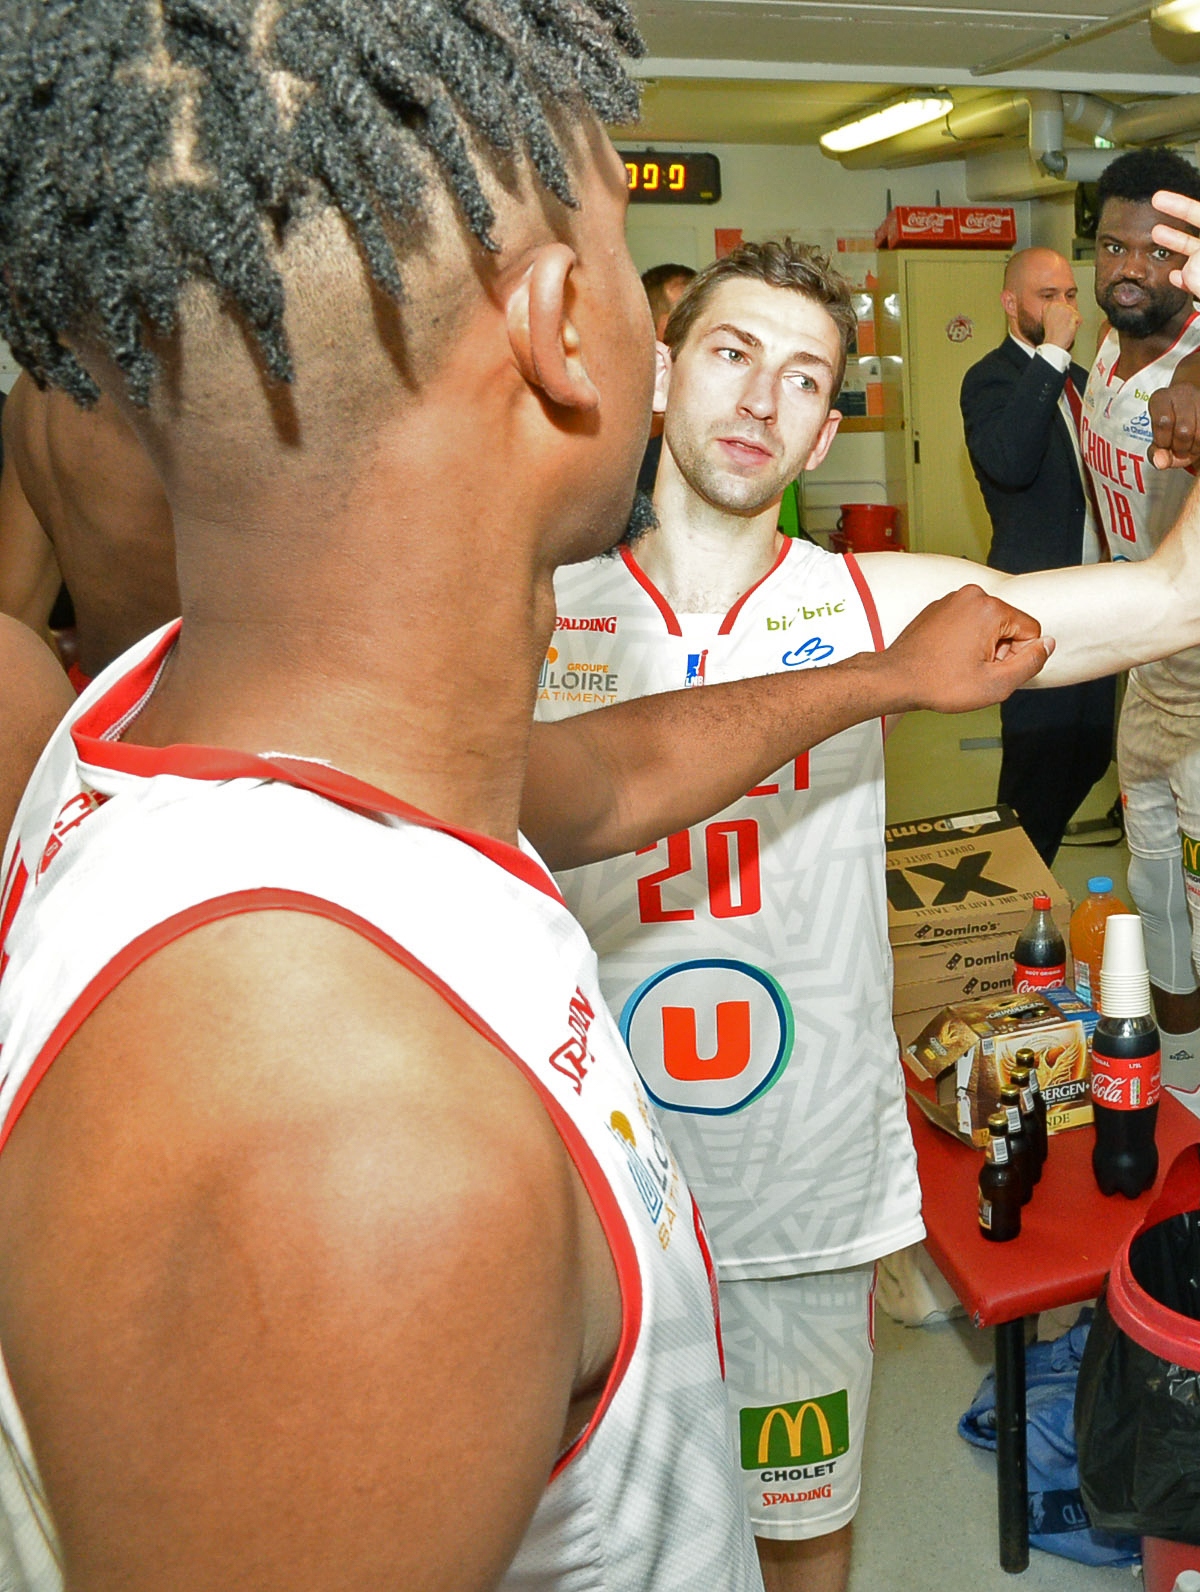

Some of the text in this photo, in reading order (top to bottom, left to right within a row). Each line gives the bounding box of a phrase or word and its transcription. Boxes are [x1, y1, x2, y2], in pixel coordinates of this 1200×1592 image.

[1081, 415, 1146, 495] CHOLET
[1102, 483, 1137, 543] 18
[554, 616, 617, 635] PALDING
[567, 662, 609, 674] GROUPE
[549, 671, 618, 692] LOIRE
[886, 819, 949, 843] Domi
[635, 818, 762, 924] 20
[933, 921, 998, 938] Domino's
[964, 951, 1015, 968] Domino
[661, 1000, 751, 1082] U
[1040, 1081, 1086, 1101] BERGEN
[760, 1461, 837, 1482] CHOLET
[762, 1483, 832, 1507] SPALDING
